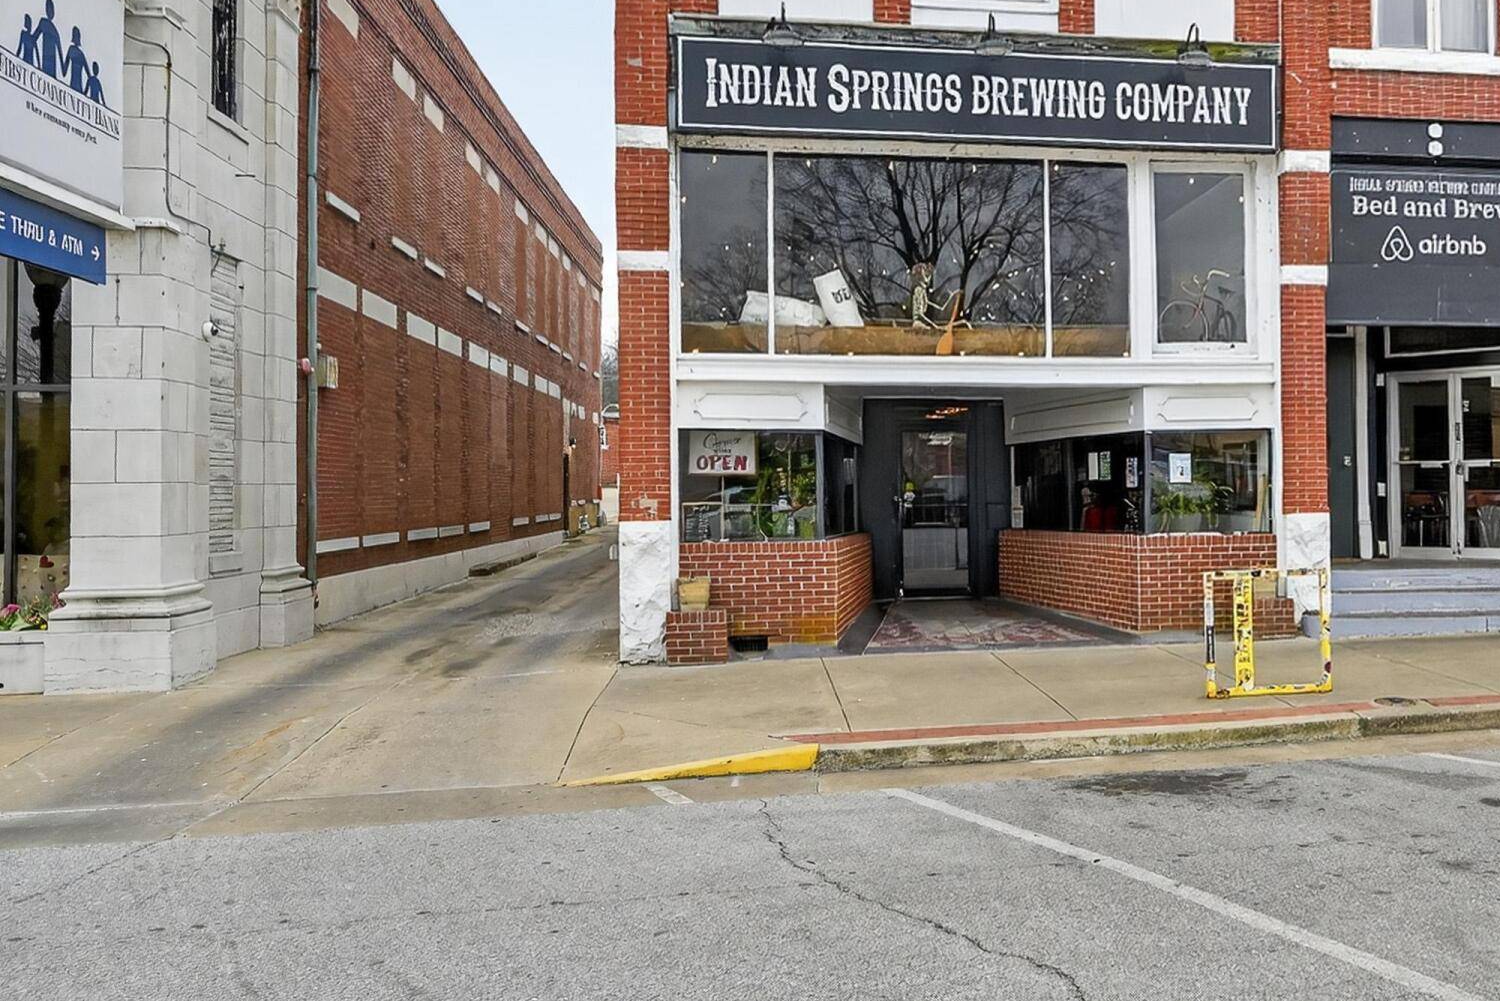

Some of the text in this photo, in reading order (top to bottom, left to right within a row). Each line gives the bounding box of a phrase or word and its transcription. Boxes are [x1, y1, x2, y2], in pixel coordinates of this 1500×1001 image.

[705, 58, 1251, 125] INDIAN SPRINGS BREWING COMPANY
[95, 106, 120, 136] BANK
[1352, 195, 1398, 216] Bed
[1403, 198, 1447, 218] and
[10, 215, 44, 242] THRU
[48, 229, 57, 247] &
[61, 233, 83, 256] ATM
[1419, 234, 1486, 255] airbnb
[696, 454, 748, 471] OPEN
